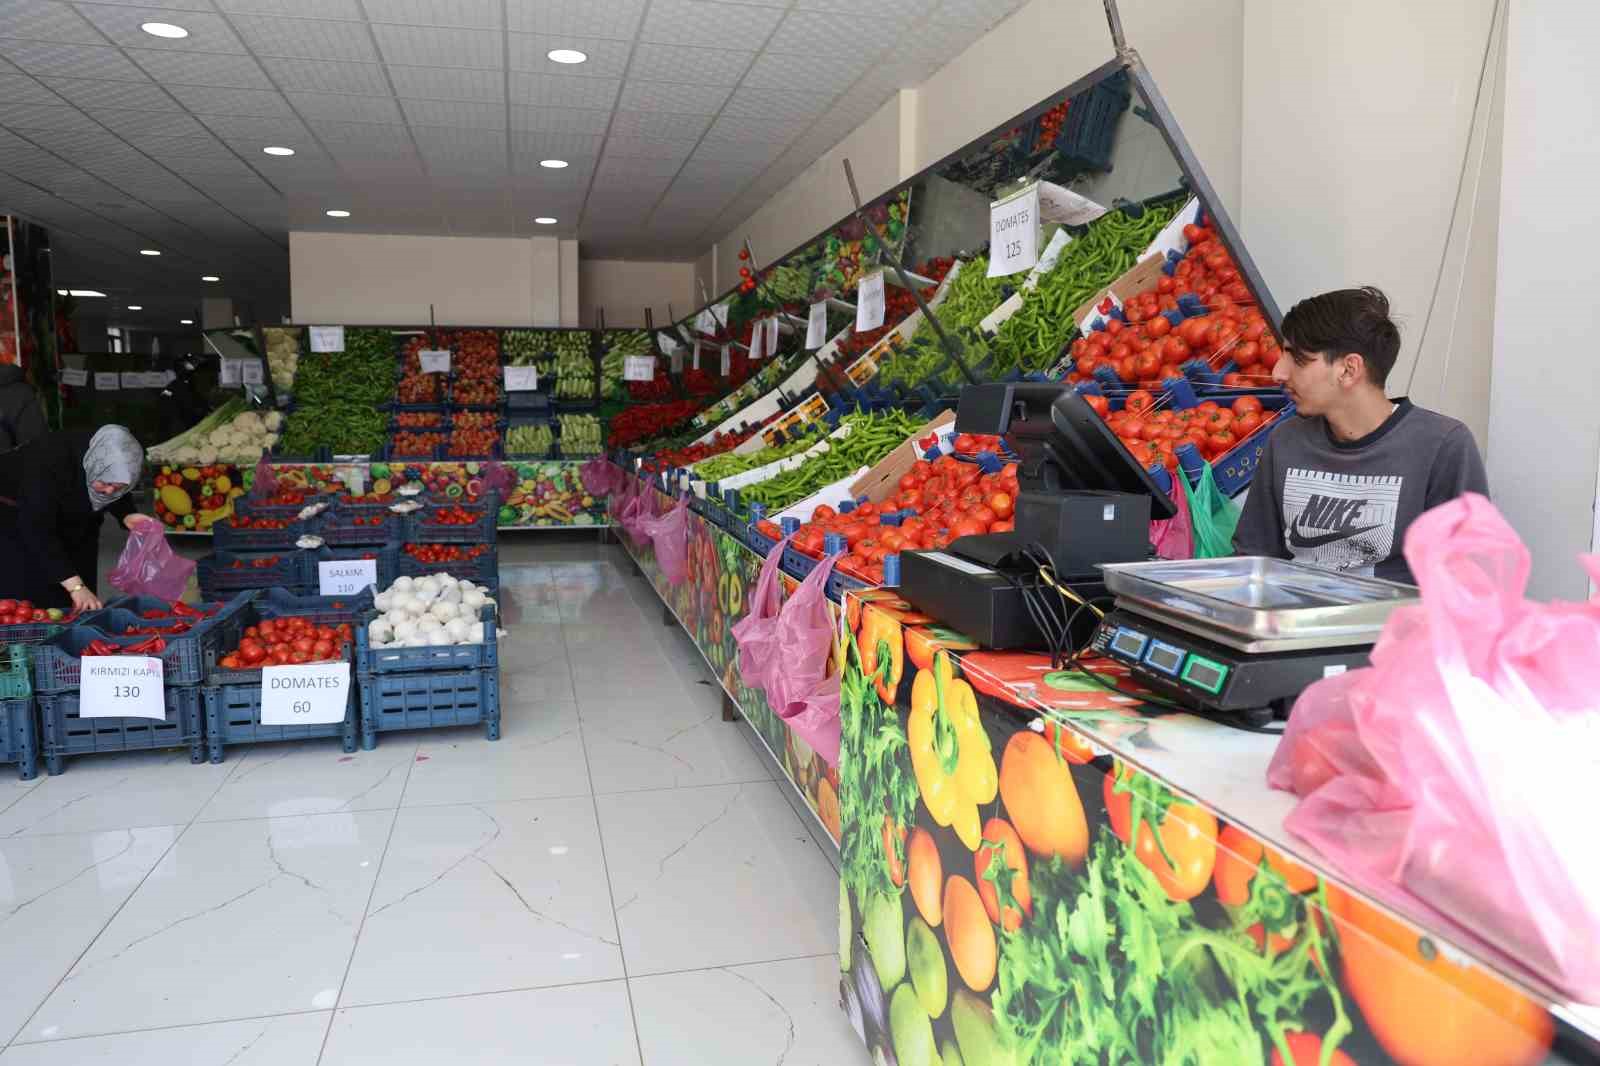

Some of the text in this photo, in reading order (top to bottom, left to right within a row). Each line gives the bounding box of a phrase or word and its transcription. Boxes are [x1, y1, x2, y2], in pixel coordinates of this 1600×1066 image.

[995, 210, 1029, 232] DOMATES
[1006, 240, 1022, 259] 125
[1299, 494, 1368, 530] NIKE
[90, 667, 130, 677] KIRMIZI
[271, 676, 340, 690] DOMATES
[114, 686, 140, 698] 130
[293, 701, 312, 713] 60
